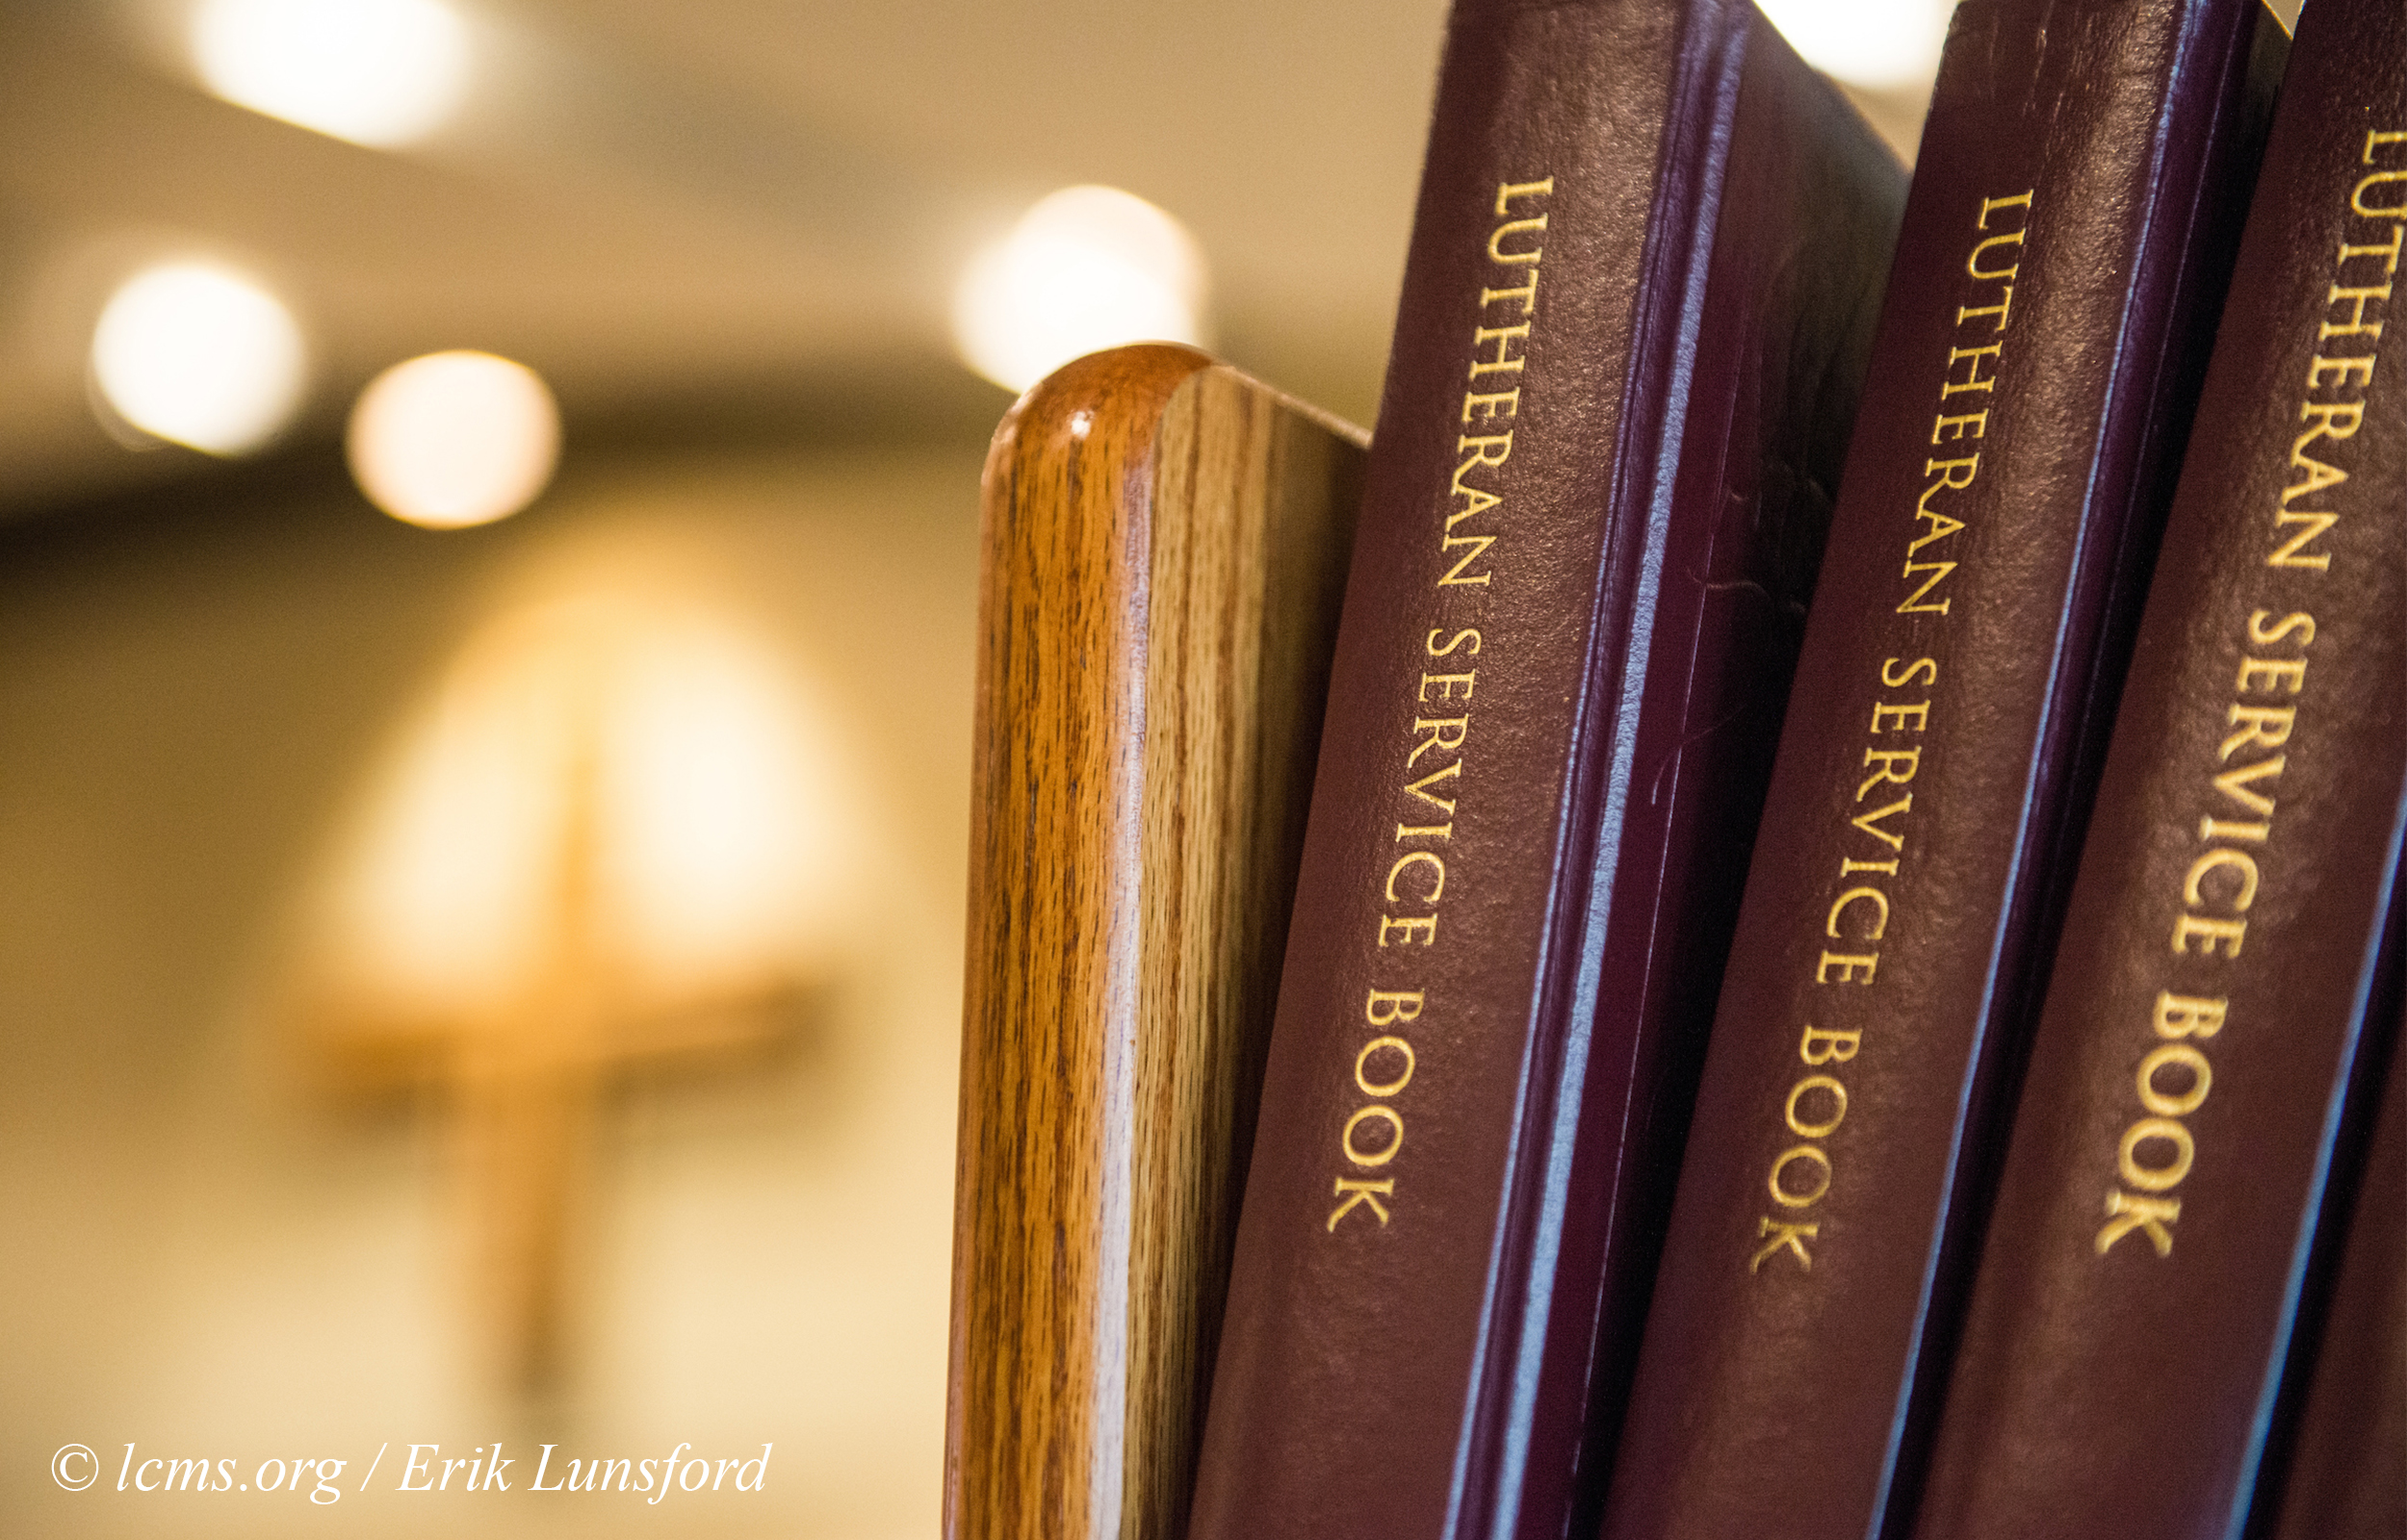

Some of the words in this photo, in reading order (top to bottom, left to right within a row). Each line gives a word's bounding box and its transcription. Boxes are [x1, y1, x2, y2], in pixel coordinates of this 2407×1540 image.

[1437, 176, 1554, 587] LUTHERAN
[1897, 189, 2034, 615] LUTHERAN
[2267, 129, 2407, 573] LUTHERAN
[1378, 628, 1483, 948] SERVICE
[1816, 657, 1937, 986] SERVICE
[2171, 608, 2316, 960] SERVICE
[1327, 988, 1426, 1233] BOOK
[1749, 1024, 1863, 1273] BOOK
[2094, 990, 2230, 1257] BOOK
